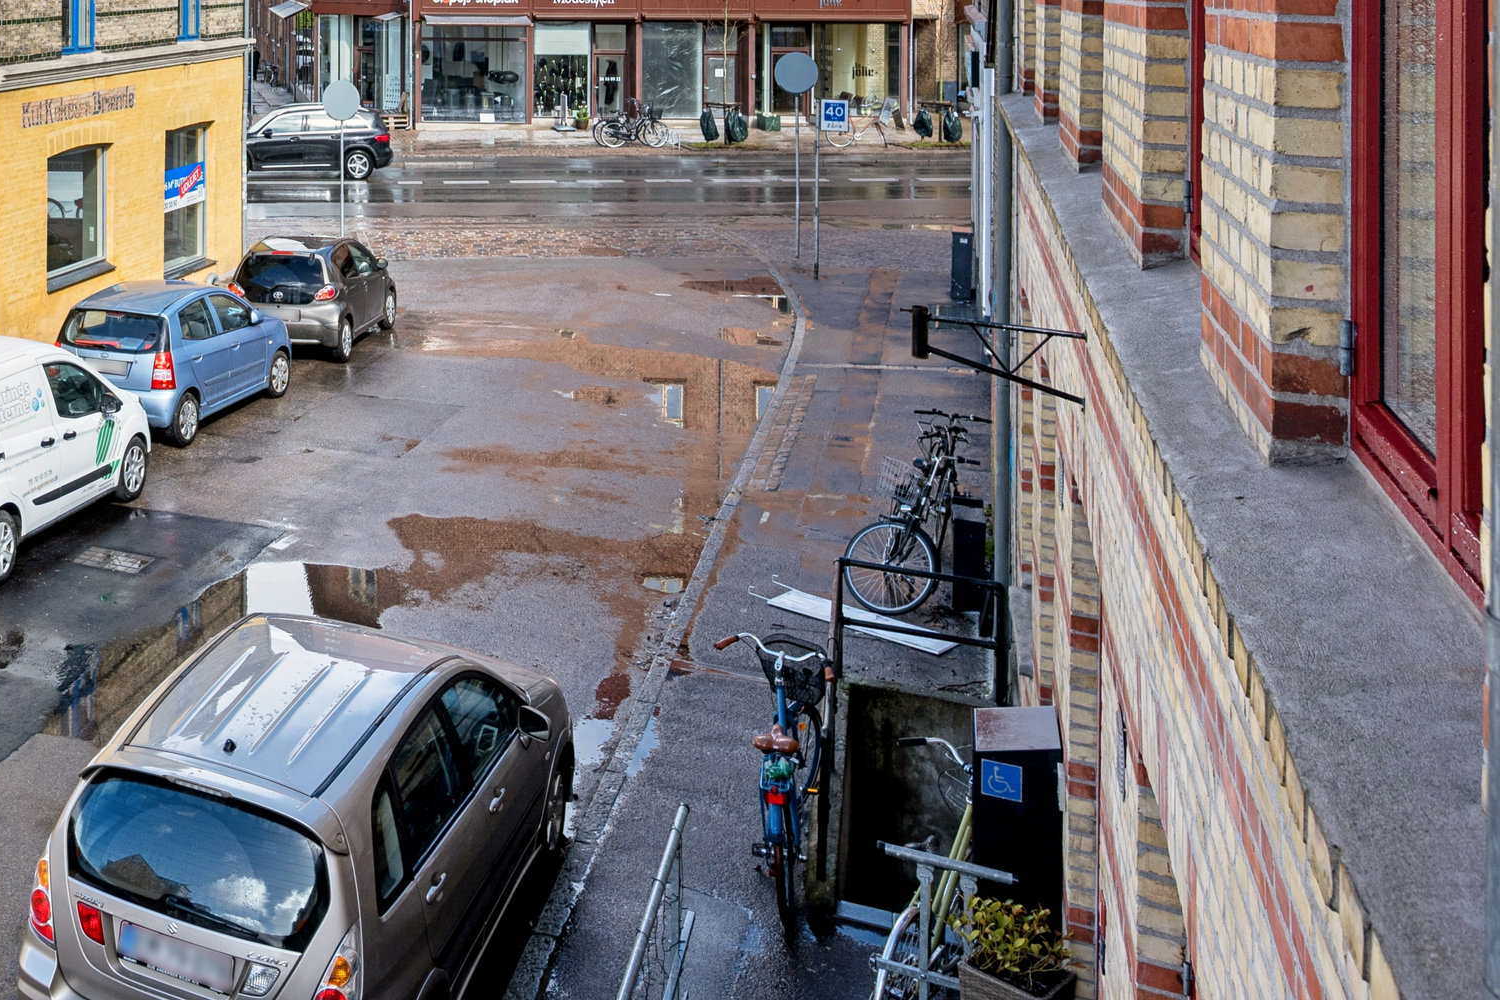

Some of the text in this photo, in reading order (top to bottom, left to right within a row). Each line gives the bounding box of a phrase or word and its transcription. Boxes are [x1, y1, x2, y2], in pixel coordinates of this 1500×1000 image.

[825, 106, 844, 117] 40
[74, 891, 104, 908] SUZUKI
[247, 951, 288, 968] LIANA
